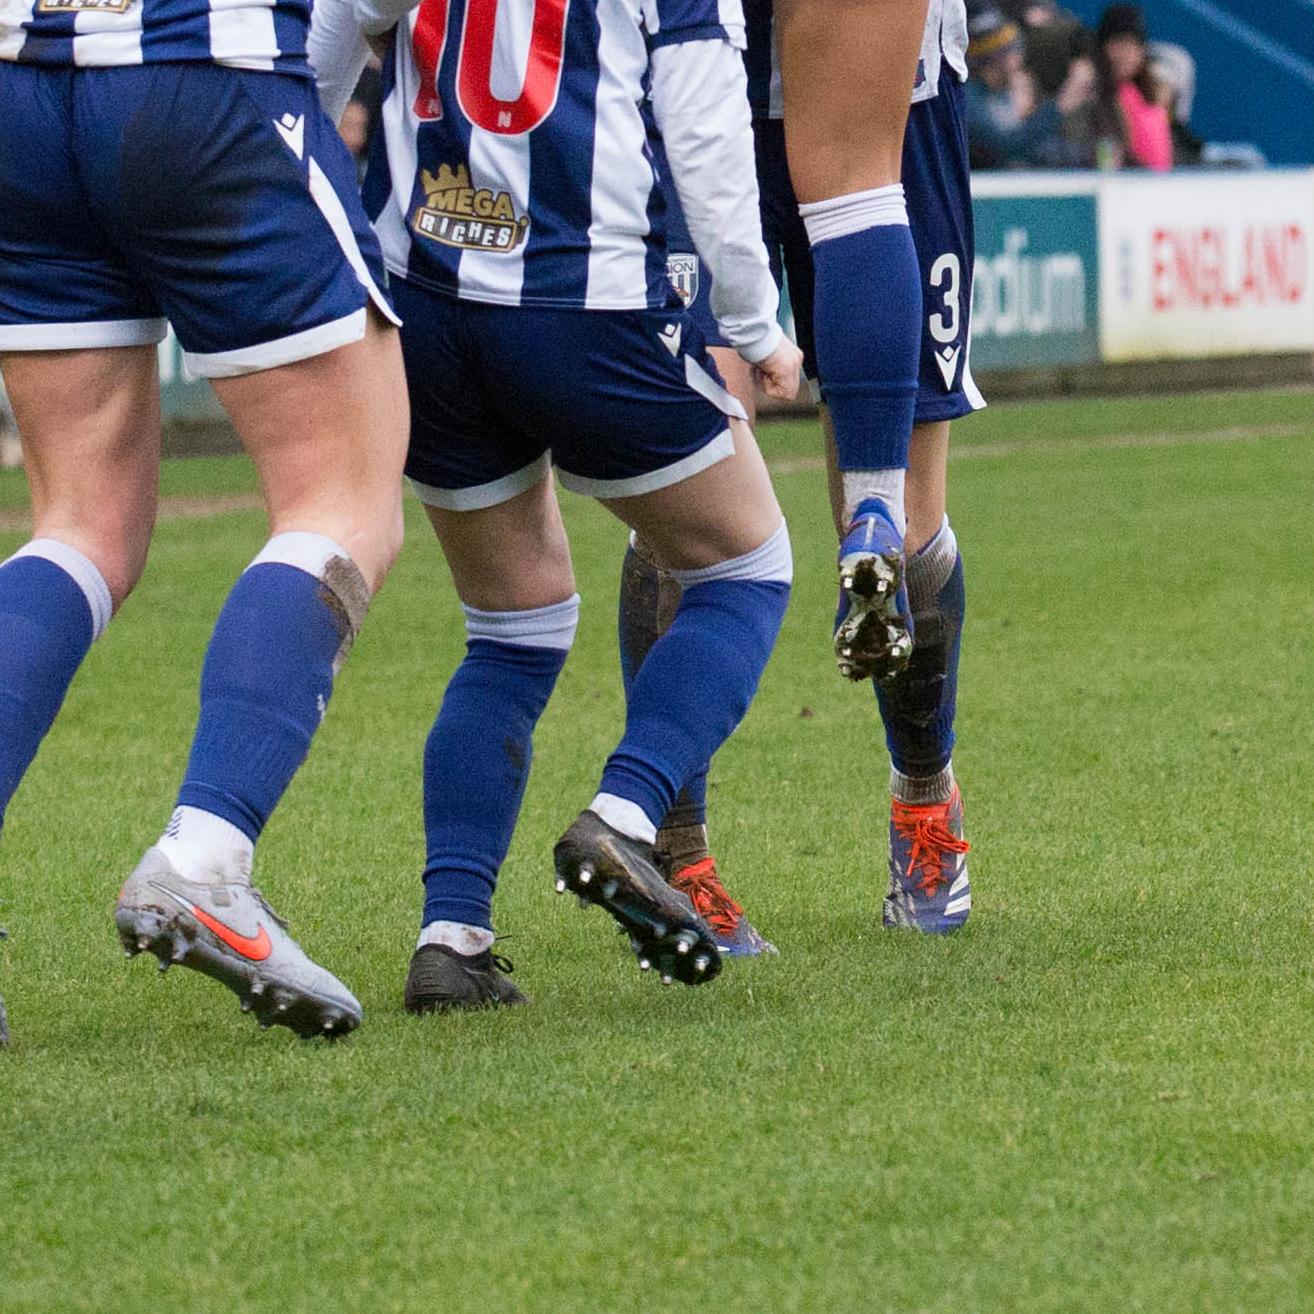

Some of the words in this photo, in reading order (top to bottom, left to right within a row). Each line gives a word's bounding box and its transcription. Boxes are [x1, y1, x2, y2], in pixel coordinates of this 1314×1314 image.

[420, 212, 512, 247] RICHES
[426, 187, 516, 221] MEGA
[929, 252, 960, 343] 3
[1150, 223, 1306, 311] ENGLAND
